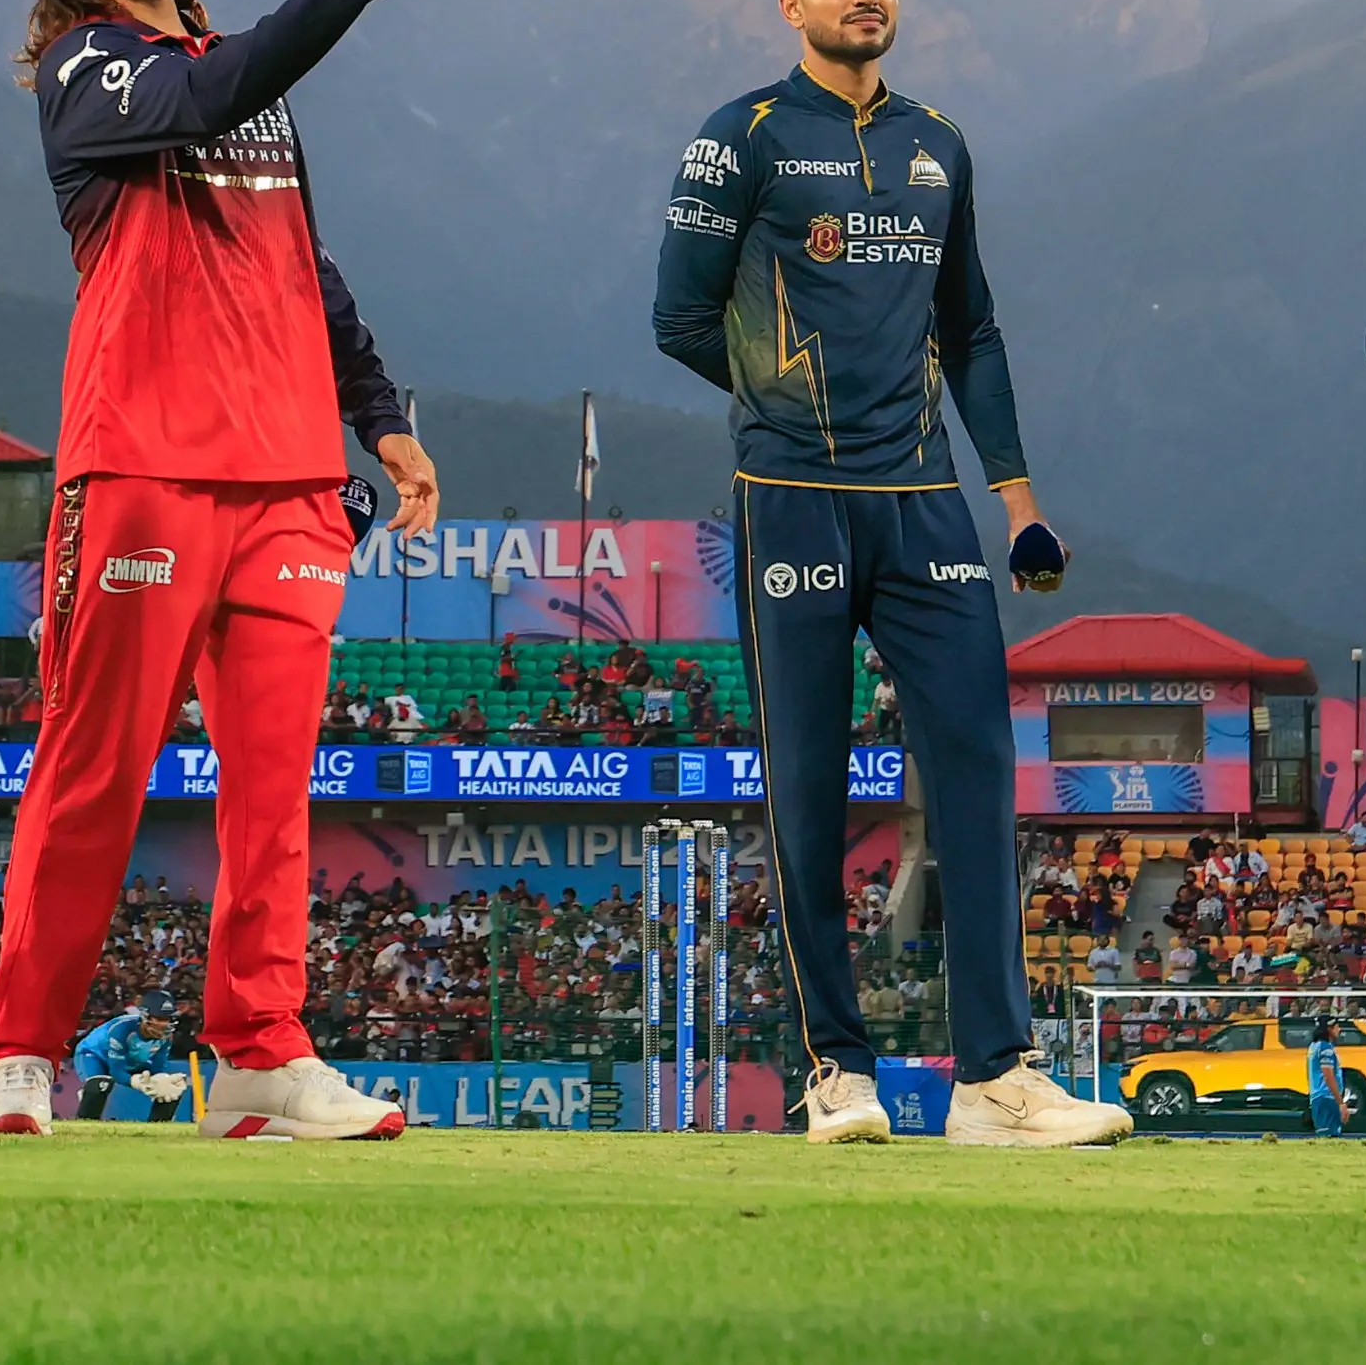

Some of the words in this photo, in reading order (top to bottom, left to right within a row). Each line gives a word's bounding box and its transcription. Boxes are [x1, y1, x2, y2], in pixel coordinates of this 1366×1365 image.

[682, 138, 741, 175] ASTRAL
[774, 160, 861, 177] TORRENT
[683, 162, 726, 187] PIPES
[847, 212, 925, 235] BIRLA
[846, 240, 942, 266] ESTATES
[106, 556, 173, 585] EMMVEE
[803, 563, 845, 591] IGI
[1041, 683, 1101, 703] TATA
[1106, 683, 1145, 703] IPL
[1149, 681, 1216, 703] 2026
[311, 750, 355, 777] IG
[452, 750, 556, 779] TATA
[566, 752, 629, 779] AIG
[848, 752, 904, 779] AIG
[459, 781, 520, 796] HEALTH
[524, 782, 622, 797] INSURANCE
[417, 824, 552, 868] TATA
[651, 849, 660, 916] tataaig.com
[684, 843, 695, 924] tataaig.com
[718, 851, 727, 917] tataaig.com
[651, 954, 660, 1021] tataaig.com
[683, 945, 695, 1026] tataaig.com
[718, 954, 727, 1021] tataaig.com
[651, 1059, 660, 1127] tataaig.com
[717, 1059, 727, 1126] tataaig.com
